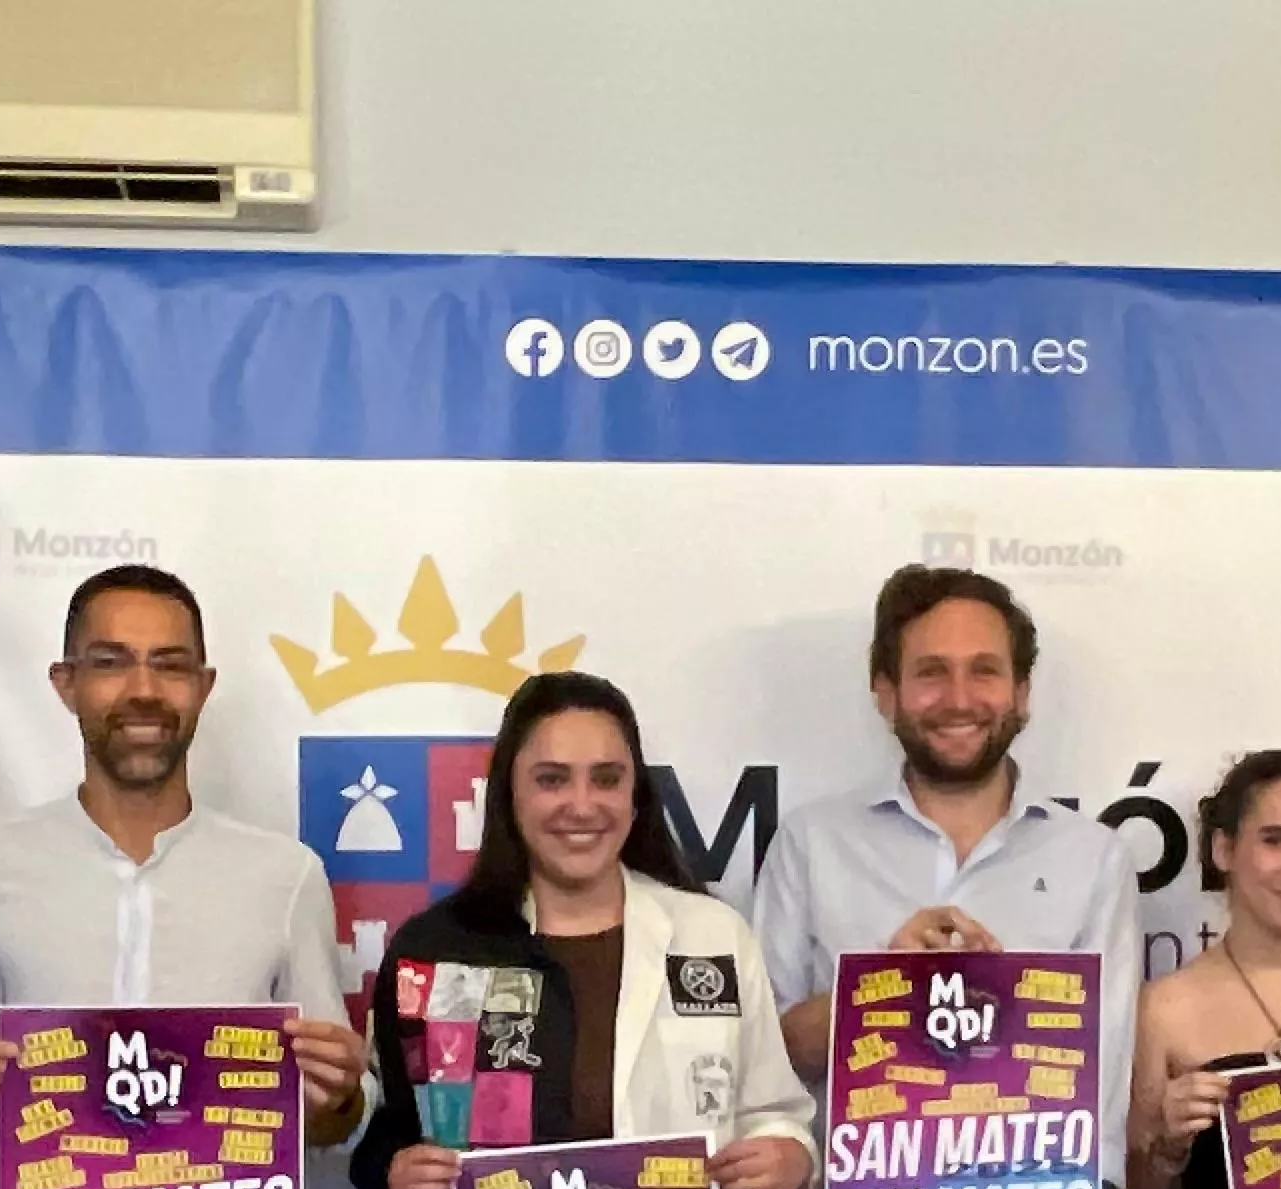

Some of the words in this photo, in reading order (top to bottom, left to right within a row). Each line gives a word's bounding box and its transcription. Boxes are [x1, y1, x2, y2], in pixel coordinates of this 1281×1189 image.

[808, 333, 1088, 375] monzon.es
[13, 527, 158, 560] Monzón
[988, 537, 1124, 567] Monzón
[929, 972, 965, 1007] M
[927, 1004, 994, 1048] QD!
[108, 1031, 148, 1070] M
[106, 1064, 183, 1114] QD!
[828, 1119, 923, 1183] SAN
[934, 1110, 1093, 1175] MATEO
